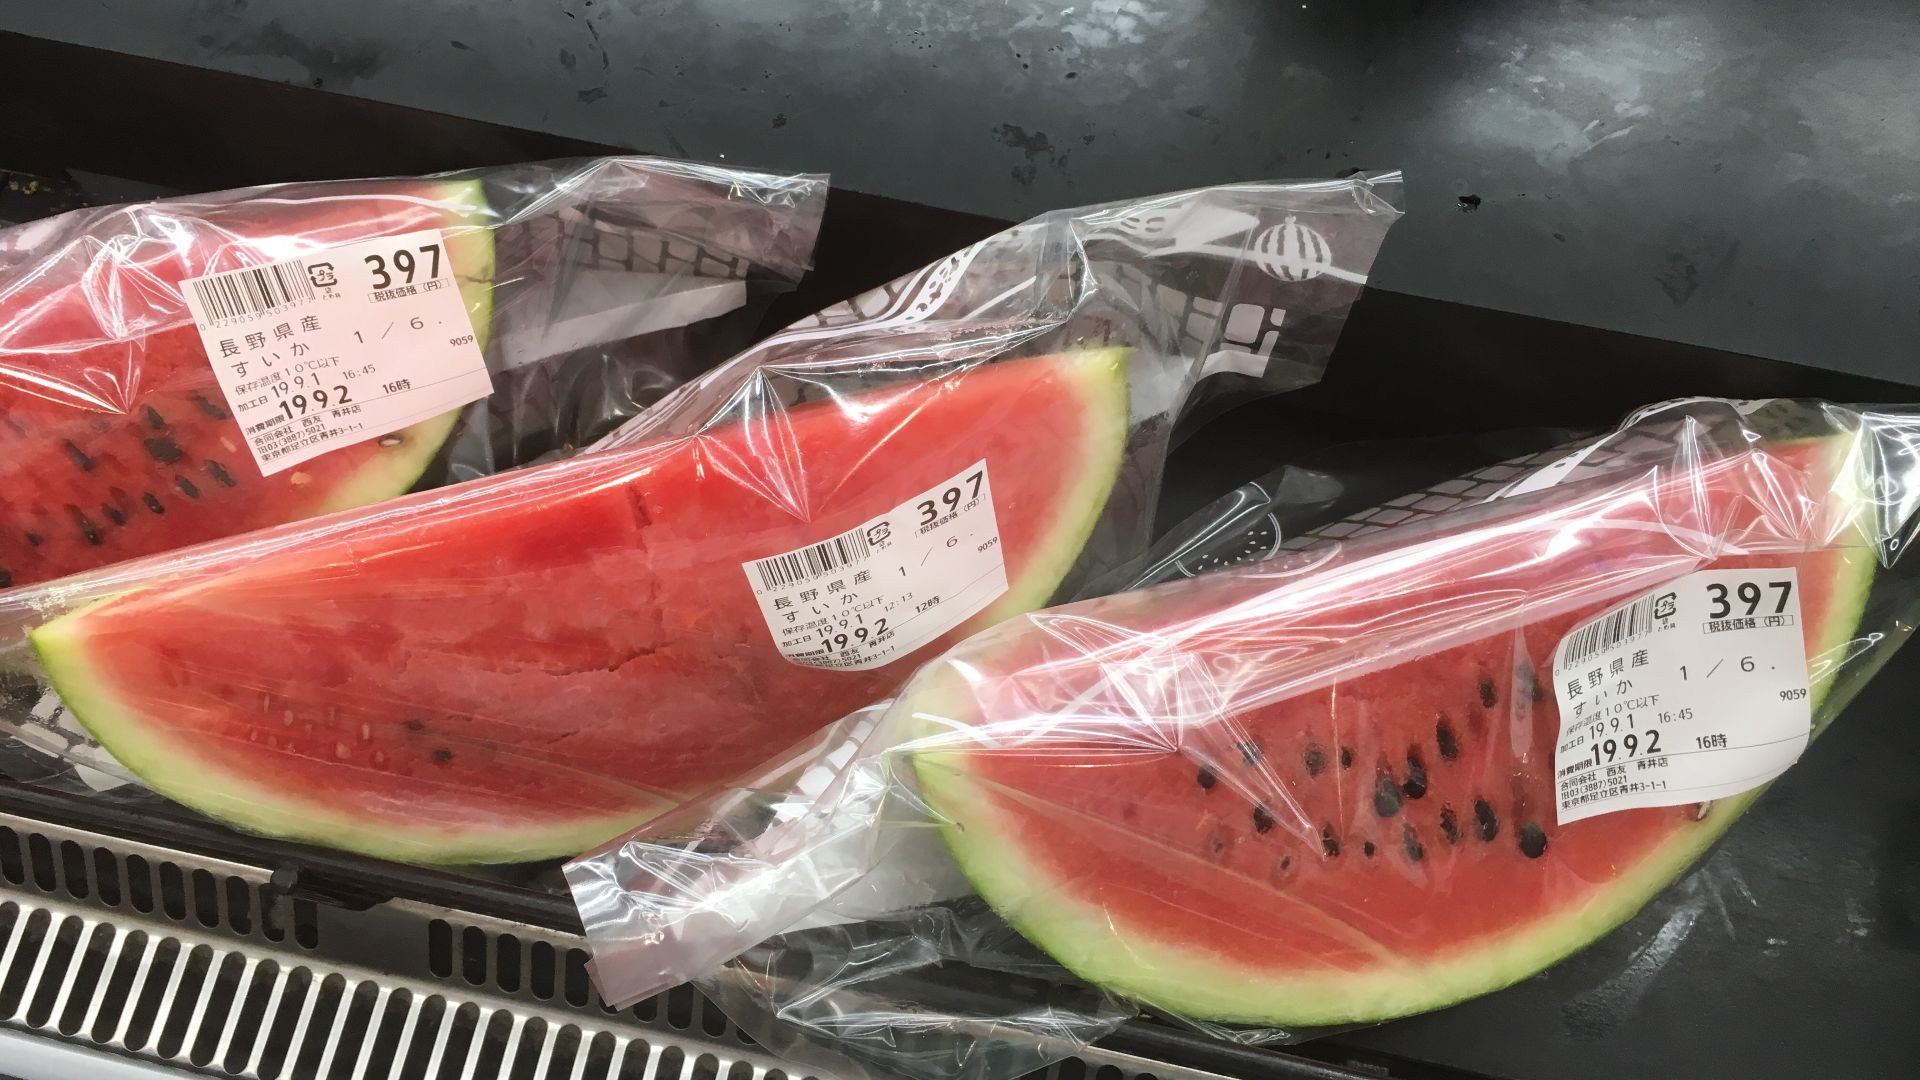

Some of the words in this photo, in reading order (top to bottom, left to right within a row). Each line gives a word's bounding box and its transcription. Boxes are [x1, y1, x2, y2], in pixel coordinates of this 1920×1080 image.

[364, 243, 440, 290] 397
[219, 315, 322, 358] 長野県産
[450, 334, 474, 347] 9059
[231, 342, 310, 378] すいか
[238, 395, 268, 412] 加工日
[271, 372, 320, 398] 19.9.1
[342, 364, 376, 380] 16:45
[246, 414, 285, 436] 消費期限
[279, 385, 353, 420] 19.9.2
[382, 379, 411, 394] 16時
[254, 425, 294, 446] 合同会社
[302, 415, 323, 428] 西友
[332, 404, 361, 419] 青井店
[916, 470, 983, 526] 397
[977, 537, 998, 552] 9059
[773, 569, 872, 610] 長野県産
[782, 593, 858, 623] すいか
[1706, 581, 1792, 619] 397
[816, 613, 863, 638] 19.9.1
[884, 592, 913, 613] 12:13
[821, 618, 889, 653] 19.9.2
[1567, 649, 1649, 700] 長野県産
[1573, 680, 1633, 718] すいか
[1779, 688, 1807, 701] 9059
[1589, 713, 1634, 740] 19.9.1
[1658, 708, 1693, 724] 16:45
[1558, 758, 1593, 779] 消費期限
[1590, 729, 1661, 766] 19.9.2
[1695, 733, 1727, 749] 16時
[1560, 772, 1596, 791] 合同会社
[1606, 765, 1627, 777] 西友
[1637, 757, 1668, 771] 青井店
